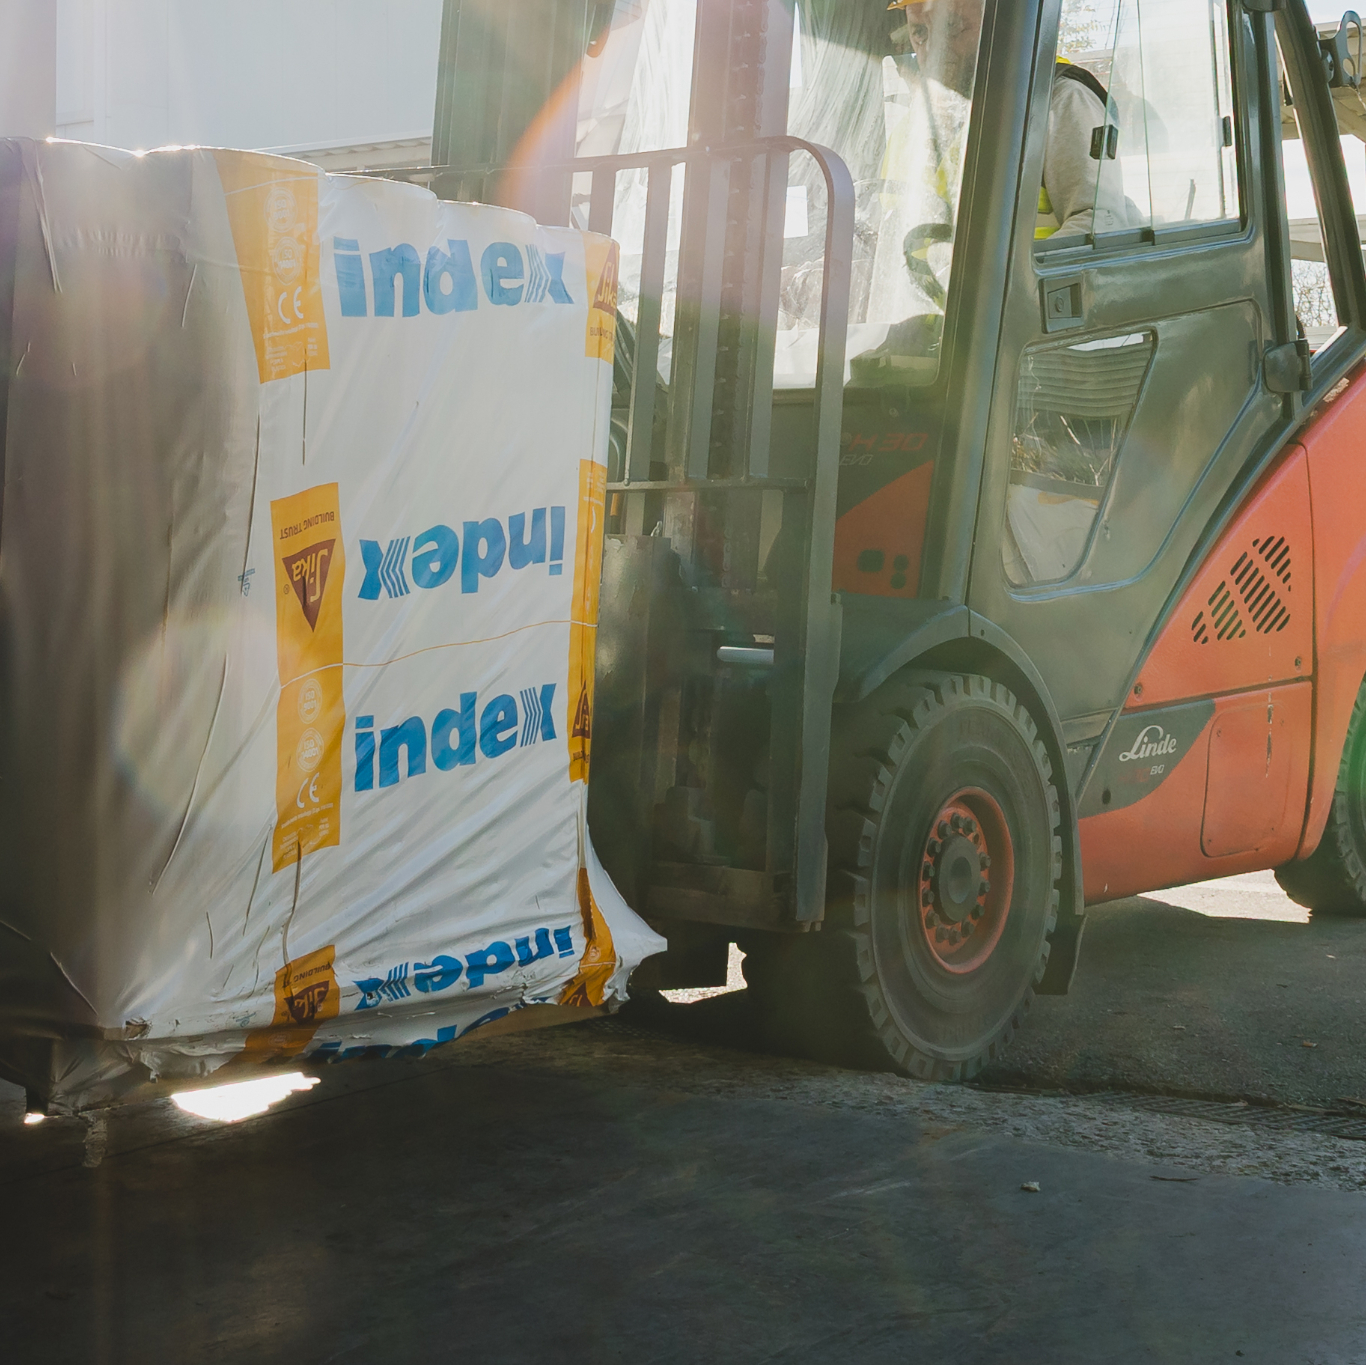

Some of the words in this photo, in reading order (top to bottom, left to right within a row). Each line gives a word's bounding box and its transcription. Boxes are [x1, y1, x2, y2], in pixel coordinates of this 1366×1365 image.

[334, 237, 575, 318] index
[279, 522, 302, 540] TRUST
[303, 510, 335, 532] BUILDING
[357, 505, 566, 601] index
[291, 548, 329, 603] Sika
[354, 682, 557, 793] index
[1118, 724, 1178, 762] Linde
[354, 924, 573, 1012] index
